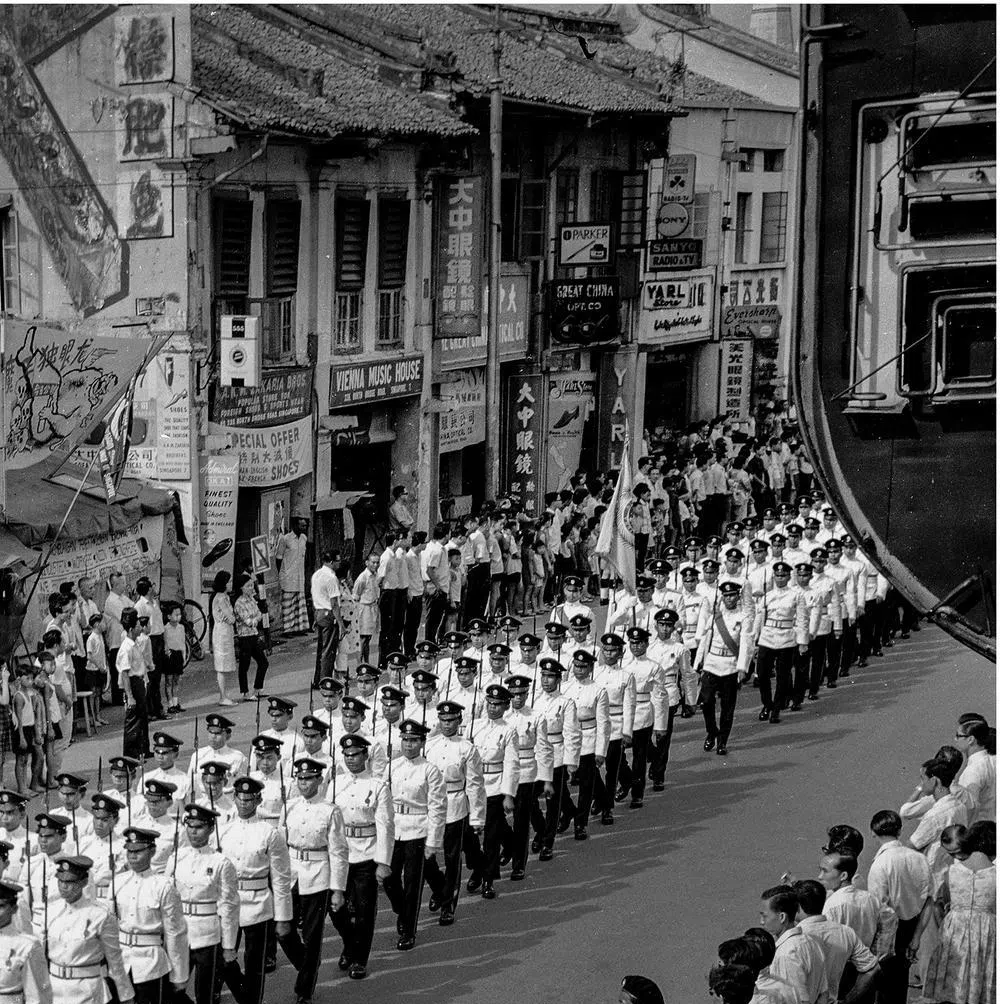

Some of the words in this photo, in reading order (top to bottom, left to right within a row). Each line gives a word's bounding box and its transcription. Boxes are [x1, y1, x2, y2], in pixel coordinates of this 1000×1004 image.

[573, 229, 608, 240] PARKER
[652, 243, 696, 253] SANYO
[652, 255, 678, 266] RADIO
[557, 284, 584, 298] GREAT
[587, 284, 614, 297] CHINA
[648, 284, 686, 299] YARL
[287, 373, 306, 391] BROS
[336, 367, 365, 393] VIENNA
[368, 363, 393, 388] MUSIC
[395, 359, 421, 383] HOUSE
[231, 432, 267, 449] PECIAL
[271, 427, 300, 448] OFFER
[271, 460, 299, 480] SHOES
[204, 490, 233, 498] FINEST
[203, 500, 233, 508] QUALITY
